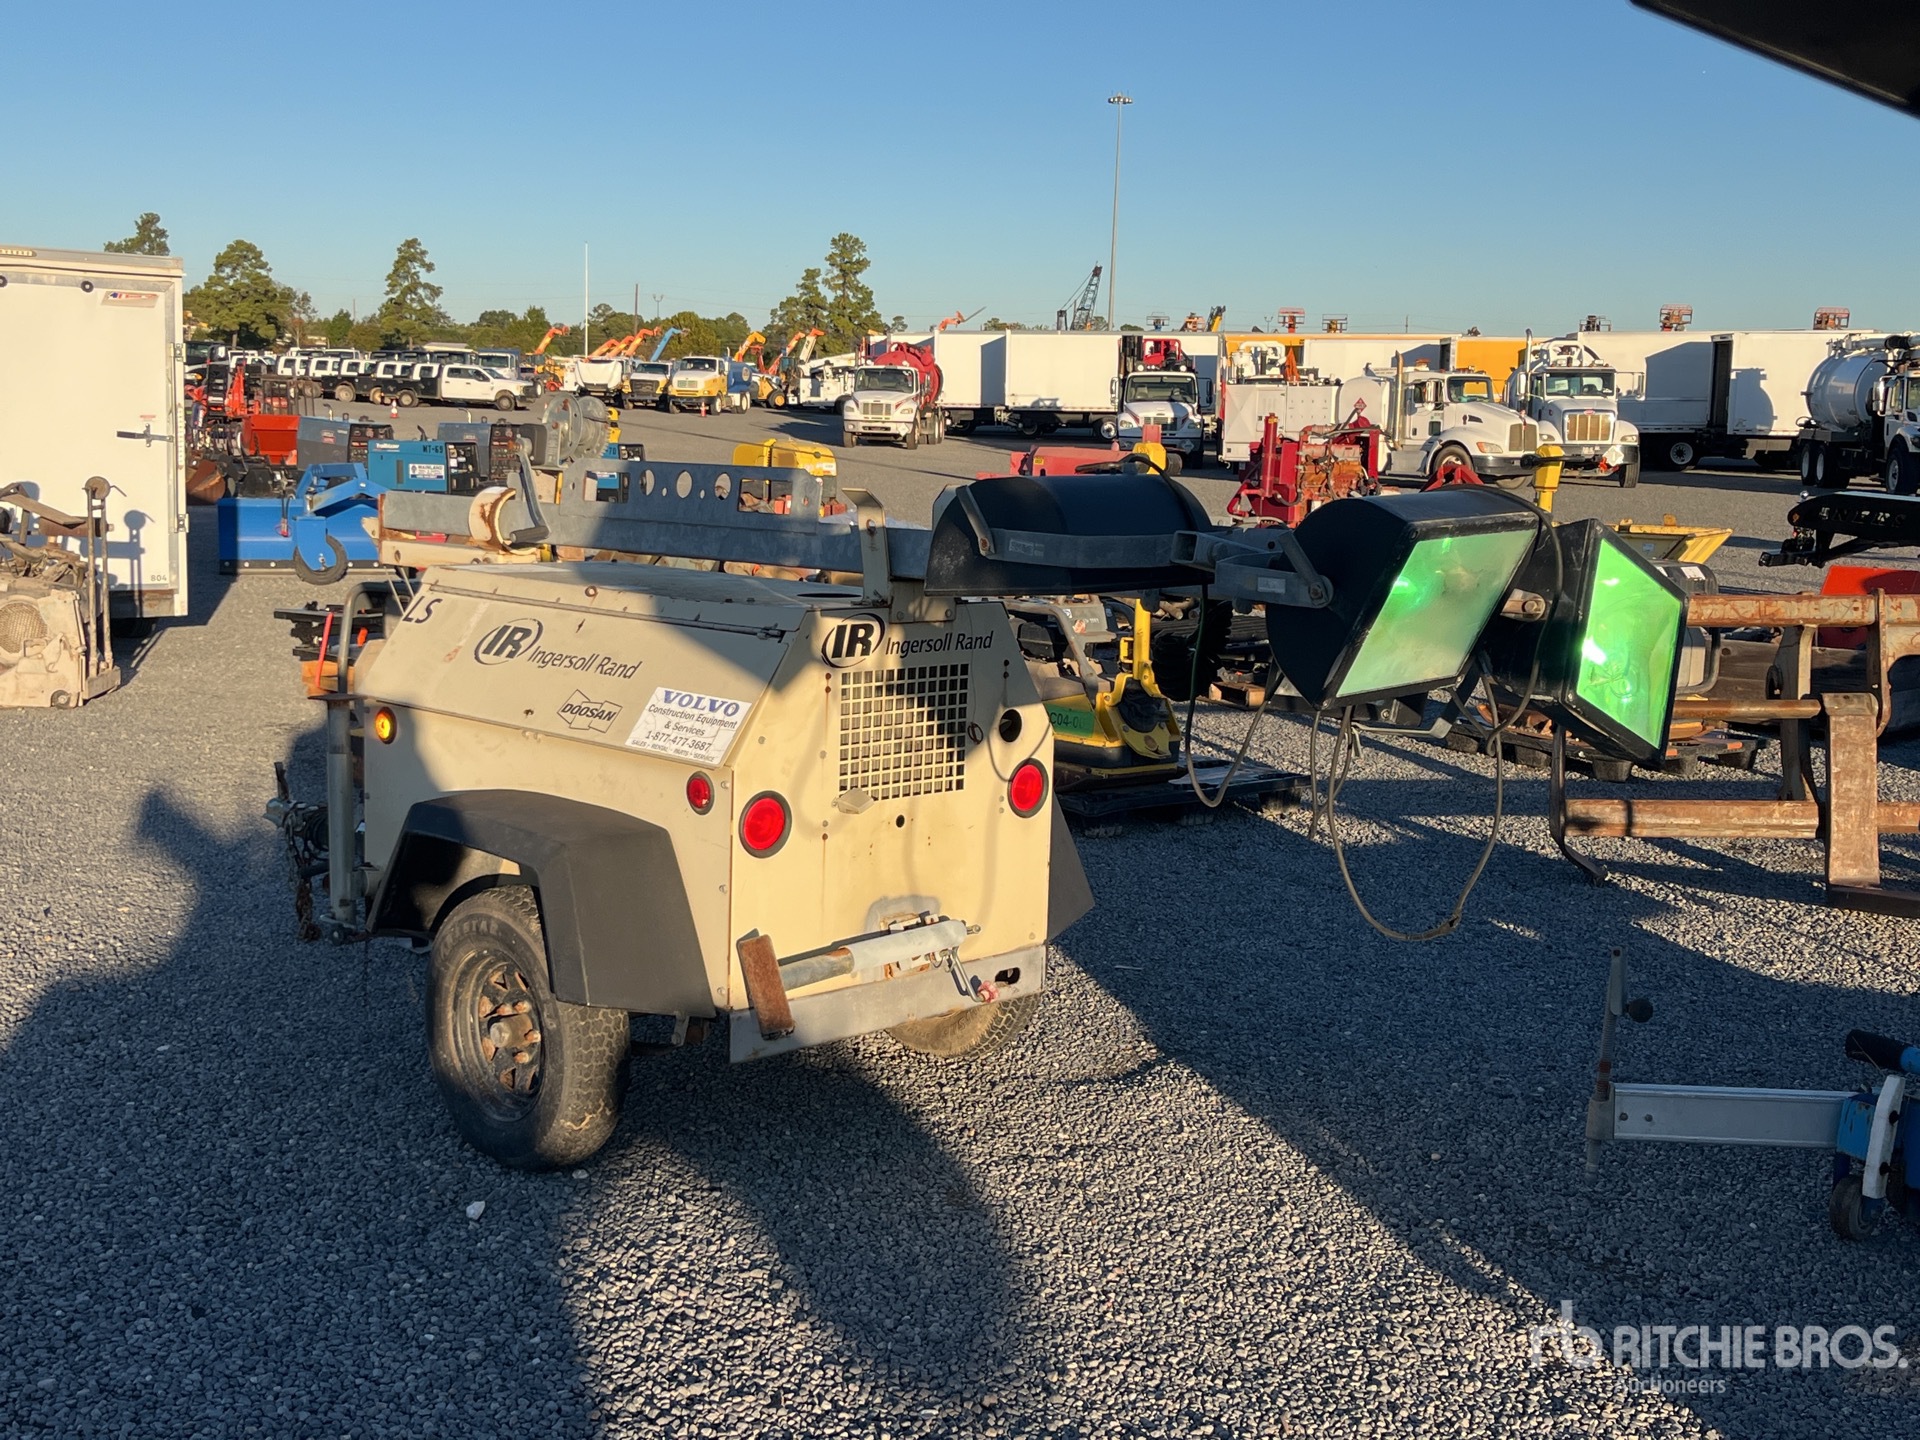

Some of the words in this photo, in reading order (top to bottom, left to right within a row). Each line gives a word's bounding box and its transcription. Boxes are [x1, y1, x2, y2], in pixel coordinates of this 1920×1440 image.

[150, 574, 167, 582] 804
[402, 595, 443, 624] LS
[481, 624, 533, 659] IR
[527, 646, 599, 673] Ingersoll
[595, 656, 643, 679] Rand
[831, 623, 875, 659] IR
[885, 632, 953, 659] Ingersoll
[955, 630, 994, 651] Rand
[560, 703, 617, 722] DOOSAN
[648, 703, 696, 721] Construction
[696, 713, 738, 729] Equipment
[664, 690, 740, 717] VOLVO
[645, 730, 712, 752] 1-877-477-3687
[664, 720, 672, 729] &
[672, 721, 706, 737] Services
[631, 739, 647, 748] SALES
[693, 752, 716, 763] SERVICE
